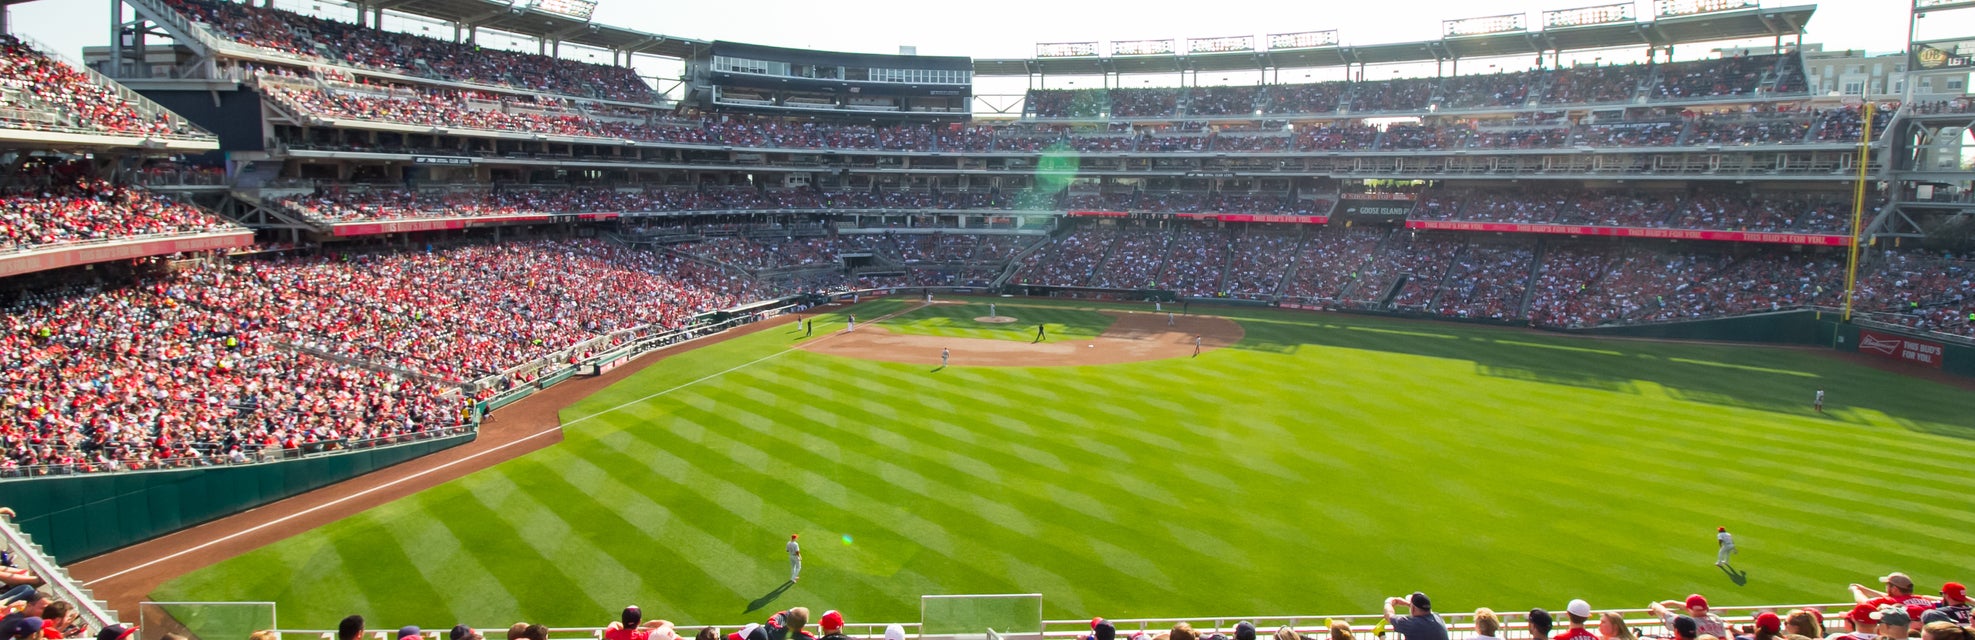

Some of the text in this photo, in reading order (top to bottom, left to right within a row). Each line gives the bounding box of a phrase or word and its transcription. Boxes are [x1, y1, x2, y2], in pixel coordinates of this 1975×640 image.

[1628, 229, 1644, 237] THIS
[1646, 229, 1667, 238] BUD'S
[1669, 230, 1683, 239] FOR
[1744, 233, 1760, 241] THIS
[1762, 234, 1788, 243] BUD'S
[1789, 235, 1806, 244] FOR
[1904, 341, 1941, 356] THIS BUD'S
[1903, 350, 1916, 360] FOR
